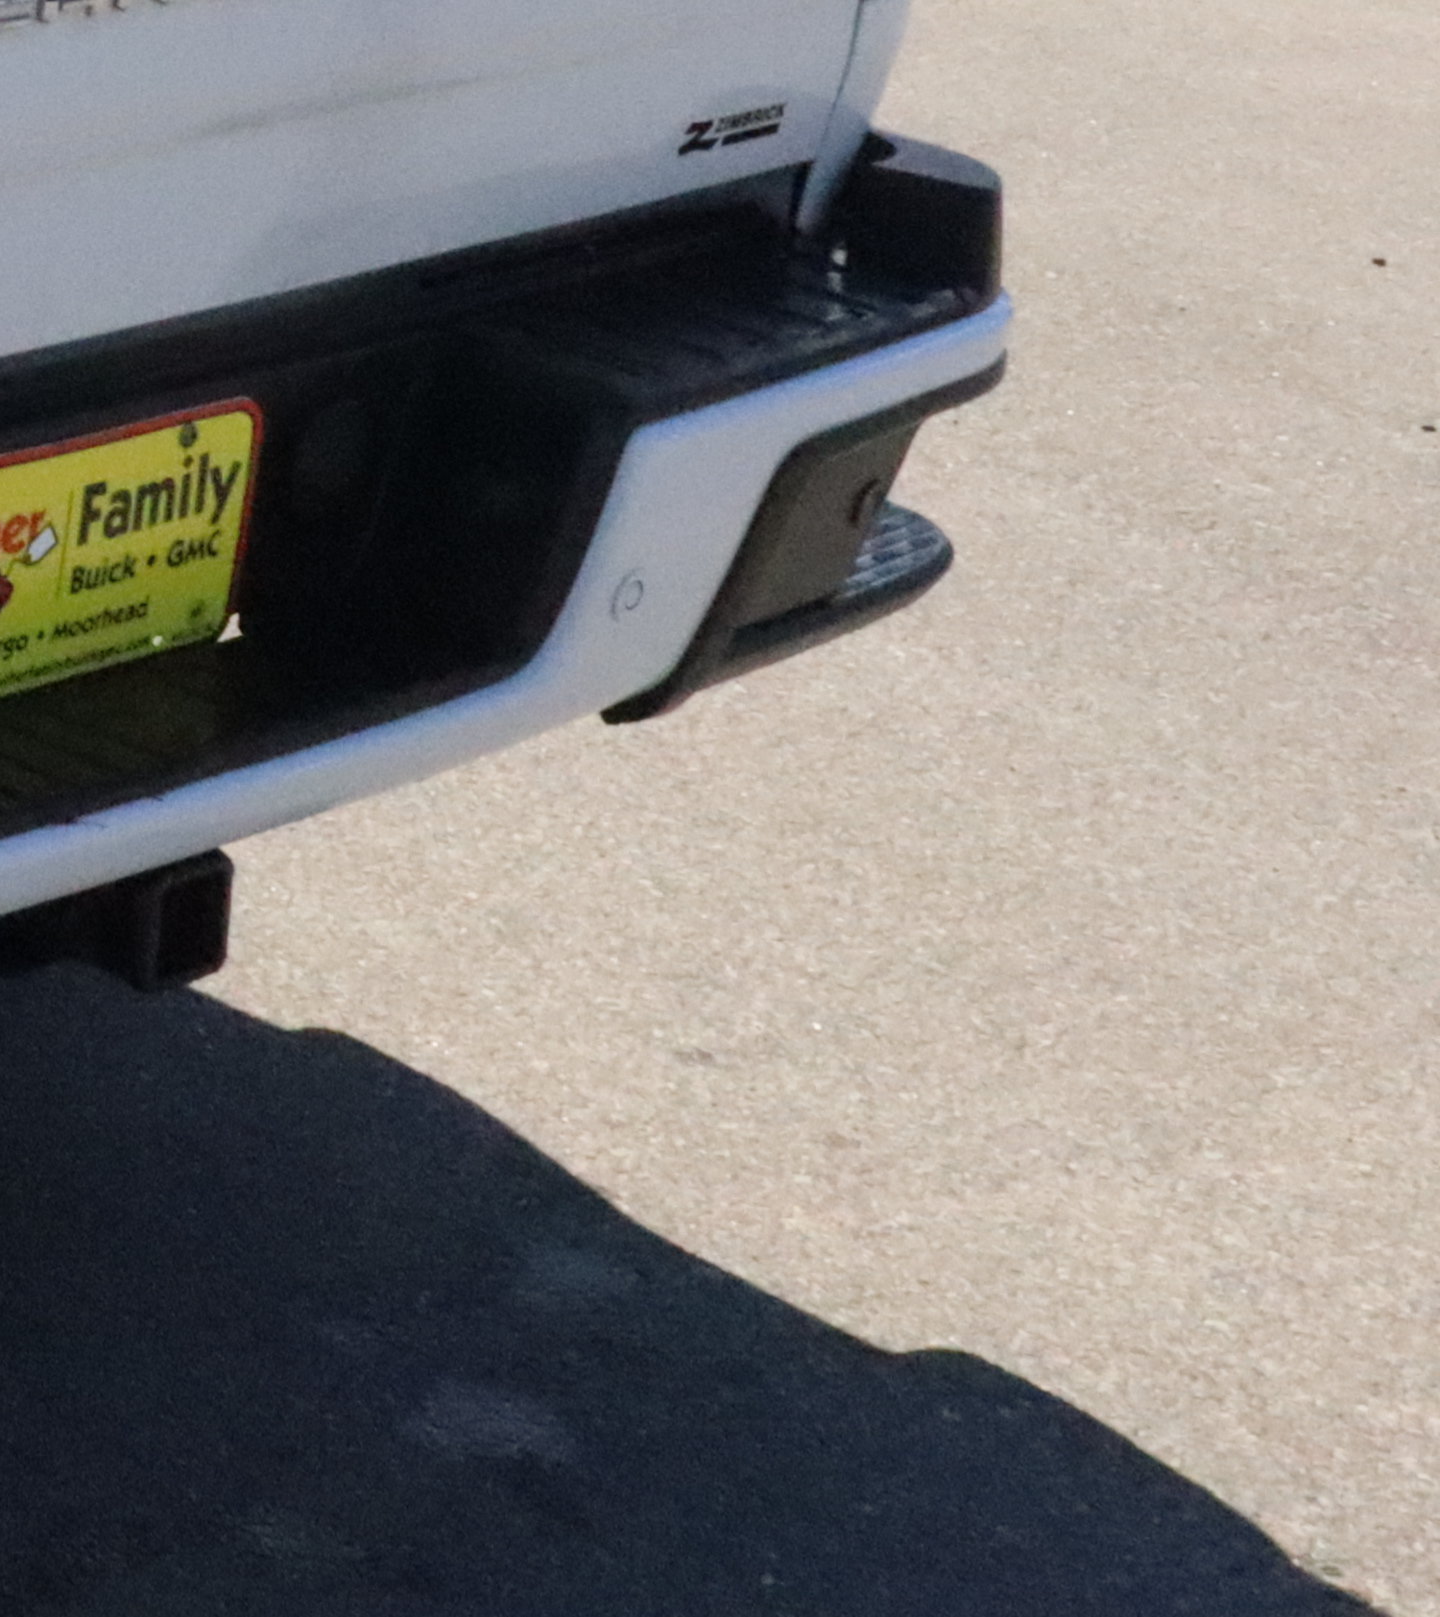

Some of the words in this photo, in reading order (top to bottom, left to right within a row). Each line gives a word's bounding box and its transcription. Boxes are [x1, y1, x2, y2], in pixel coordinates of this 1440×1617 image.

[77, 453, 242, 547] Family
[69, 553, 137, 596] Buick
[165, 530, 221, 568] GMC
[51, 598, 150, 642] Moorhead
